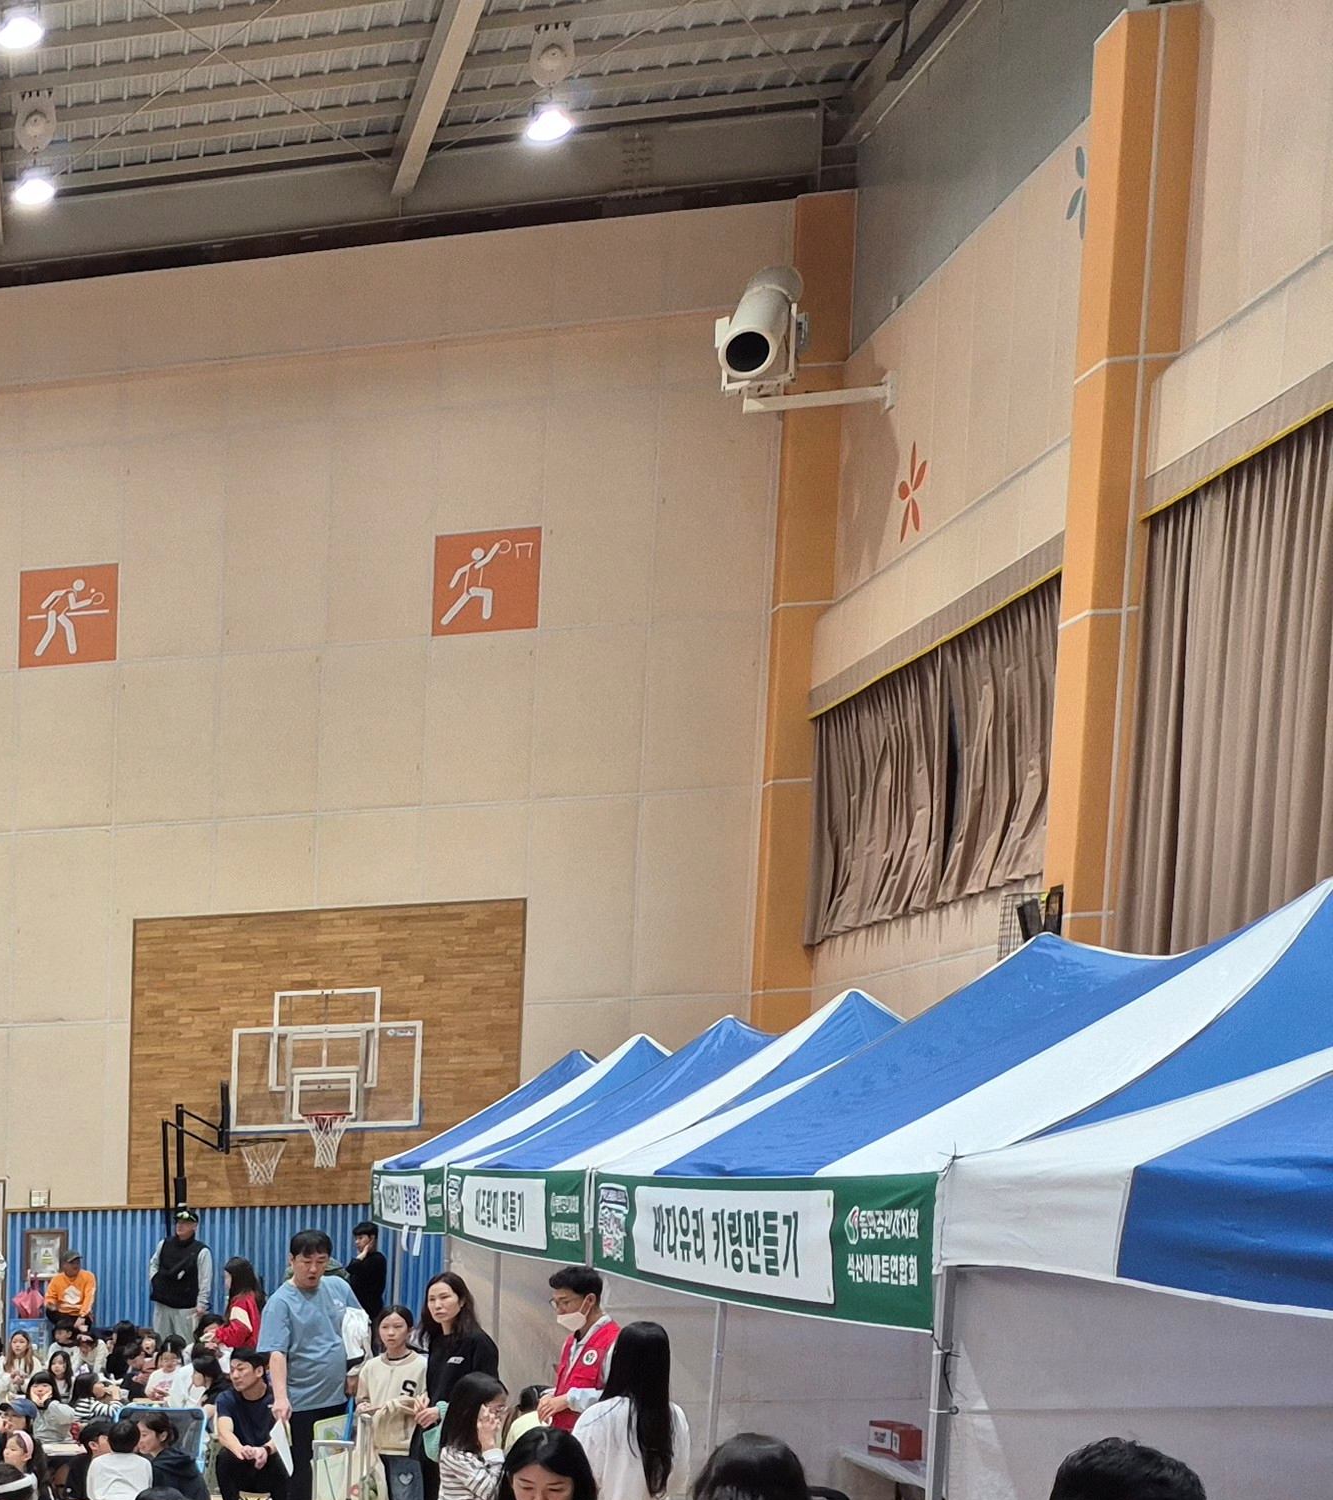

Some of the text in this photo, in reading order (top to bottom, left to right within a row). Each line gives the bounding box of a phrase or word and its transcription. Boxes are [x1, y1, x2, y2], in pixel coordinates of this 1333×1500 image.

[501, 1190, 525, 1233] 만들기
[652, 1203, 707, 1266] 바다유리
[712, 1208, 800, 1279] 키링만들기
[846, 1252, 919, 1288] 석산아파트연합회
